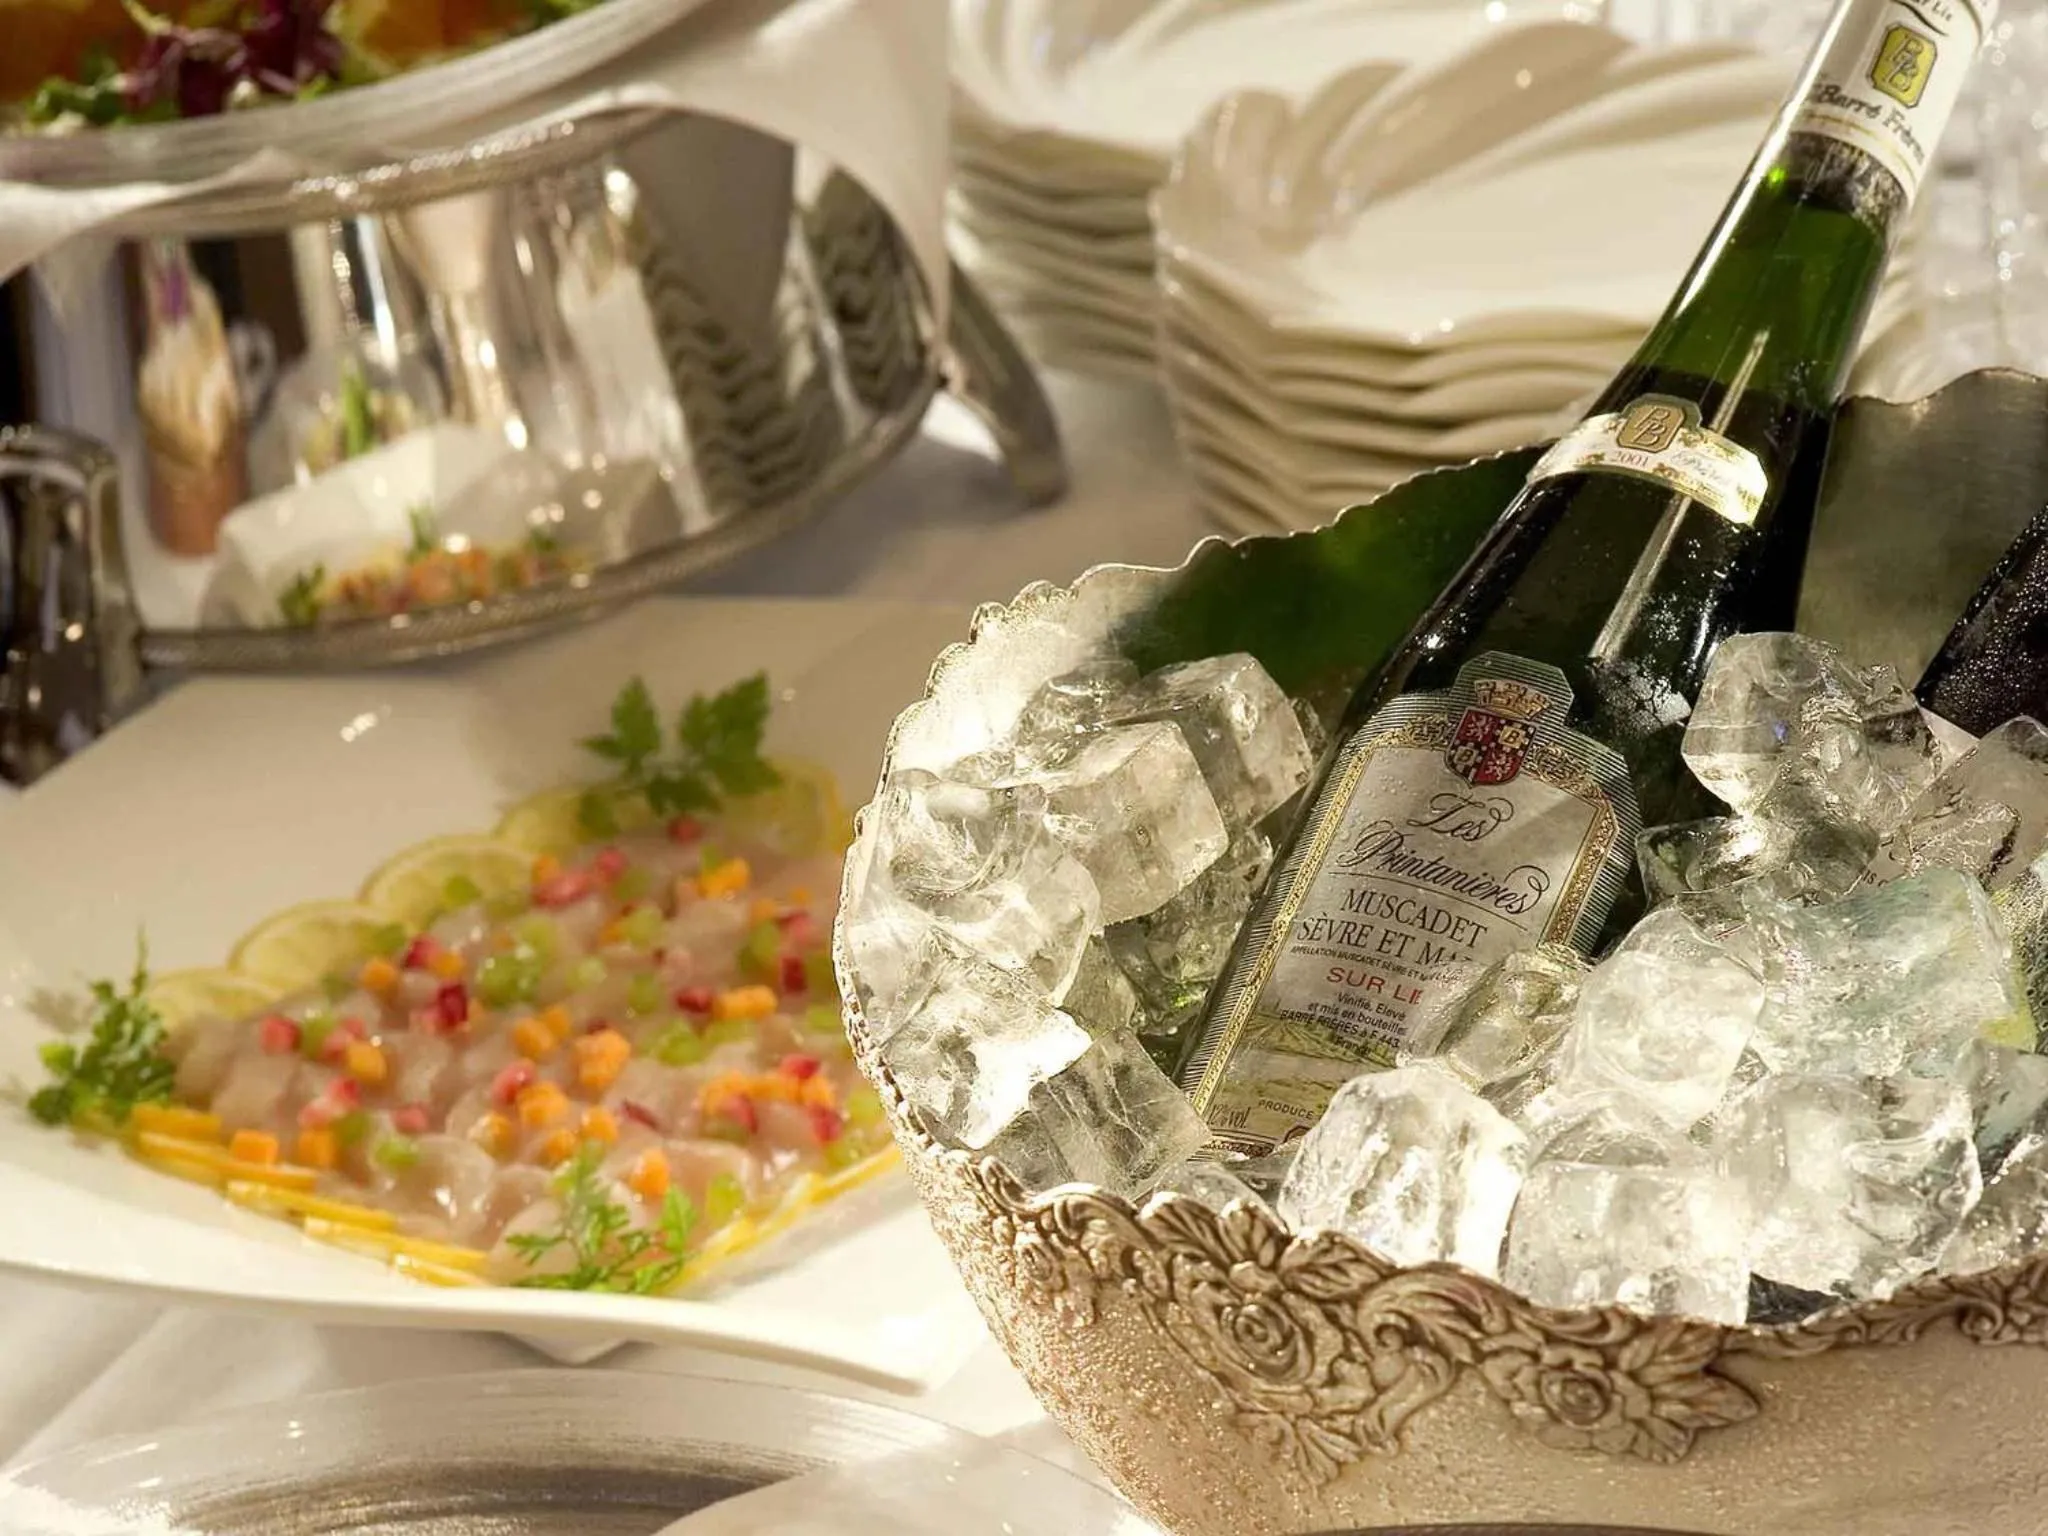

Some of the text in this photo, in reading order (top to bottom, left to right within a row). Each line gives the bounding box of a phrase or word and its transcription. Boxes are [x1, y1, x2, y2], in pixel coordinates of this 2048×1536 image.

[1406, 792, 1514, 842] Les
[1336, 819, 1550, 915] Printanières
[1297, 911, 1374, 948] SÈVRE
[1376, 928, 1417, 959] ET
[1340, 888, 1488, 949] MUSCADET
[1326, 967, 1386, 994] SUR
[1320, 1003, 1340, 1016] mis
[1340, 1008, 1356, 1020] en
[1257, 1099, 1315, 1120] PRODUCE
